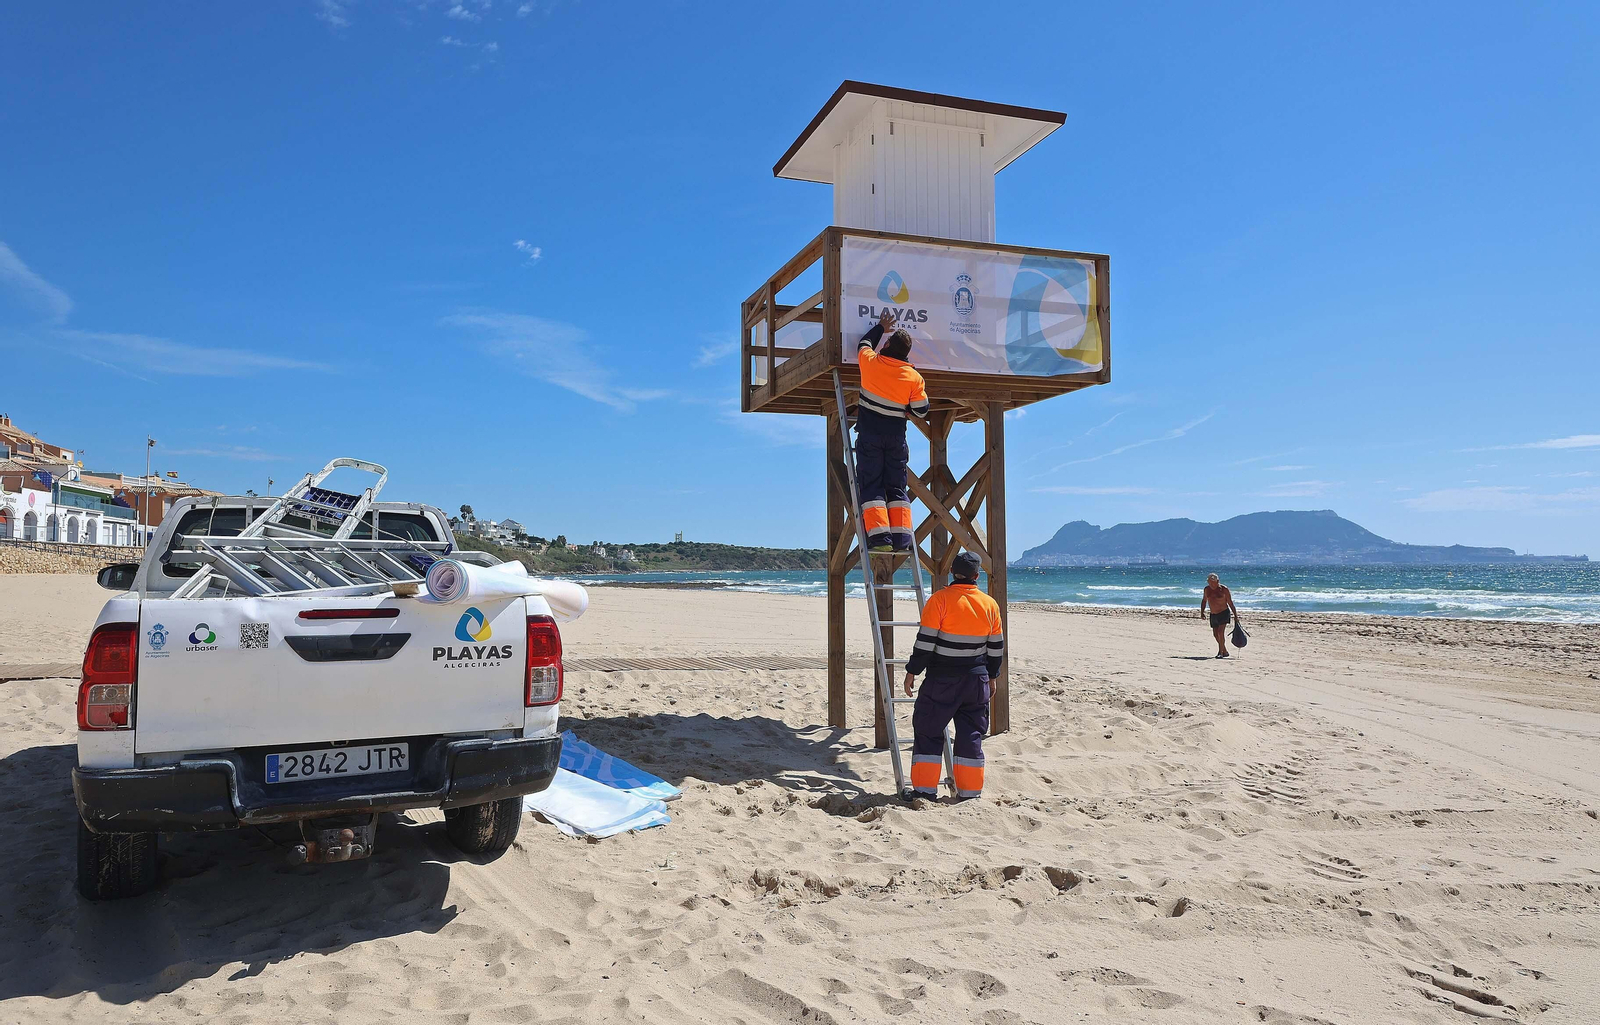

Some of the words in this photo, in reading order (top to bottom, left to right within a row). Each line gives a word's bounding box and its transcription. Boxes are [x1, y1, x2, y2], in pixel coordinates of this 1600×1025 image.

[858, 304, 928, 323] PLAYAS
[868, 321, 918, 330] ALCIRAS
[949, 321, 982, 329] Ayuntamiento
[956, 327, 982, 335] Algeciras
[185, 644, 219, 652] urbaser
[432, 645, 513, 661] PLAYAS
[443, 661, 501, 669] ALGECIRAS
[284, 751, 348, 779] 2842
[358, 746, 403, 772] JTR
